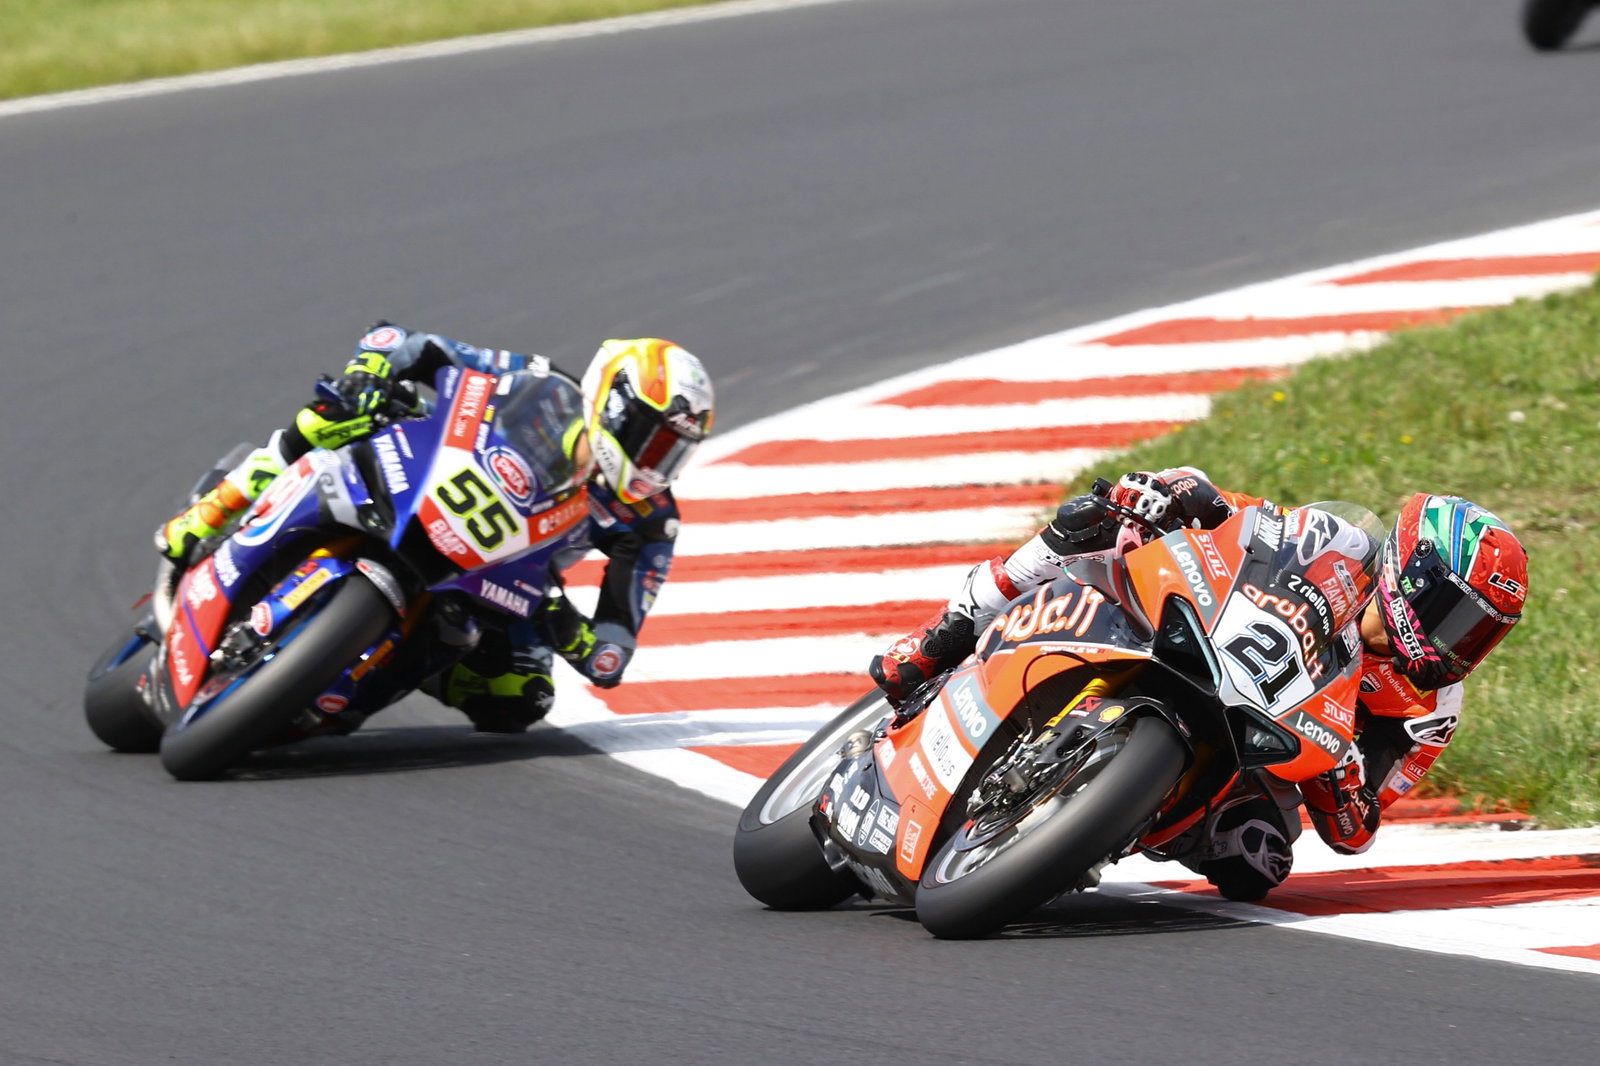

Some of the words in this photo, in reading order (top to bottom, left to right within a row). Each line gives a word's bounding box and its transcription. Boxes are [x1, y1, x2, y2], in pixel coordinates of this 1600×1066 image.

[374, 434, 409, 496] YAMAHA
[436, 468, 519, 552] 55
[480, 579, 530, 617] YAMAHA
[1170, 541, 1212, 608] Lenovo
[1324, 576, 1348, 618] FIAMM
[1488, 573, 1526, 602] LS2
[1299, 583, 1326, 617] riello
[1322, 616, 1331, 636] ups
[1391, 600, 1424, 660] Muc-Off
[1219, 620, 1303, 710] 21
[952, 678, 988, 738] Lenovo
[1295, 711, 1341, 755] Lenovo
